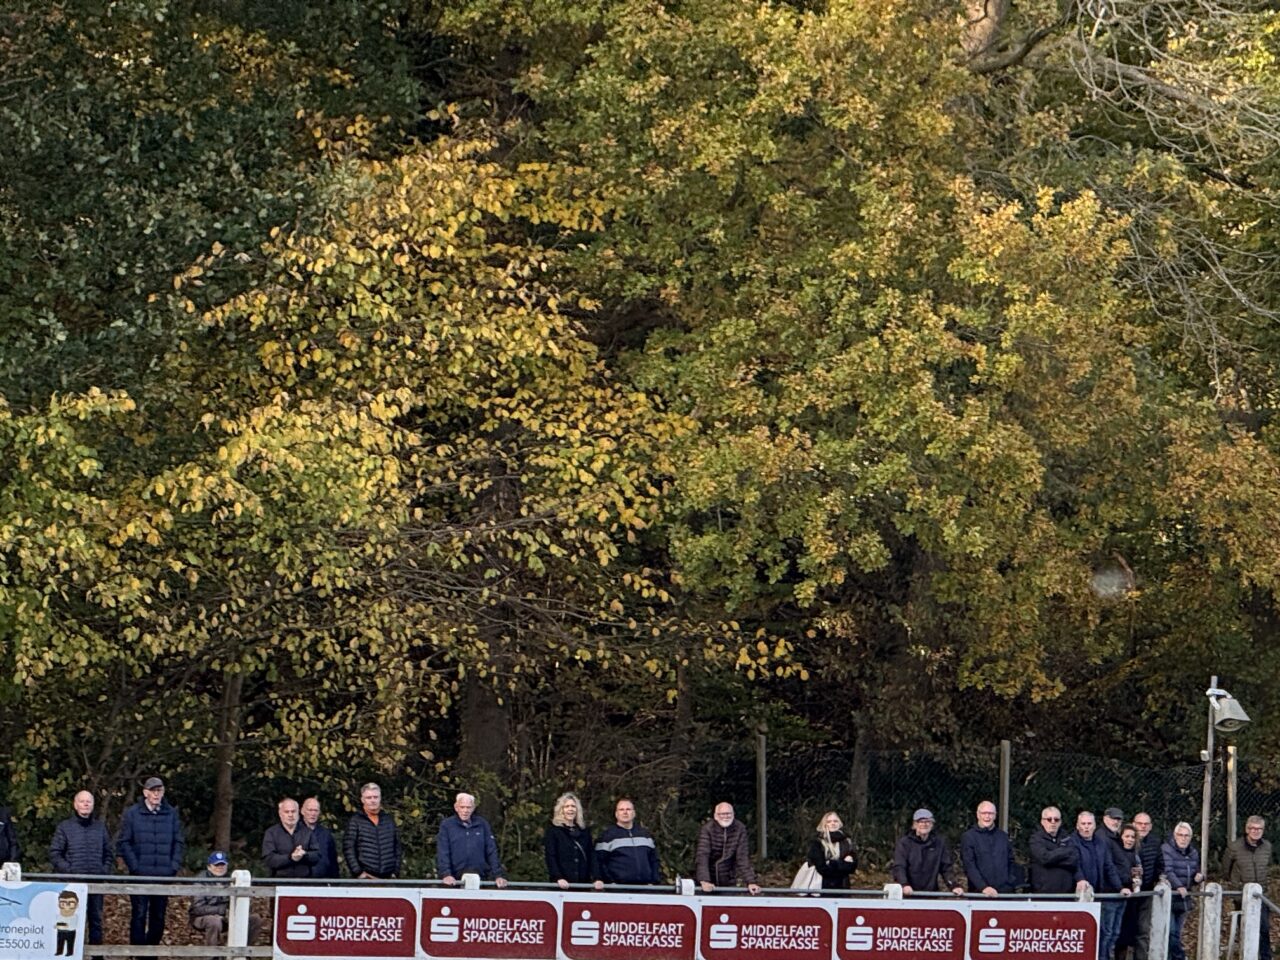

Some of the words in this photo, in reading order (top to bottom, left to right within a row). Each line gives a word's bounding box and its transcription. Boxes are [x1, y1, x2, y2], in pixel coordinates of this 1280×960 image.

[320, 916, 404, 929] MIDDELFART
[463, 918, 546, 931] MIDDELFART
[603, 921, 685, 935] MIDDELFART
[0, 924, 44, 936] ronepilot
[319, 928, 403, 942] SPAREKASSE
[741, 924, 821, 938] MIDDELFART
[877, 926, 955, 940] MIDDELFART
[1009, 928, 1086, 941] MIDDELFART
[462, 931, 544, 944] SPAREKASSE
[602, 934, 683, 948] SPAREKASSE
[740, 937, 819, 950] SPAREKASSE
[876, 939, 953, 952] SPAREKASSE
[1008, 940, 1084, 953] SPAREKASSE
